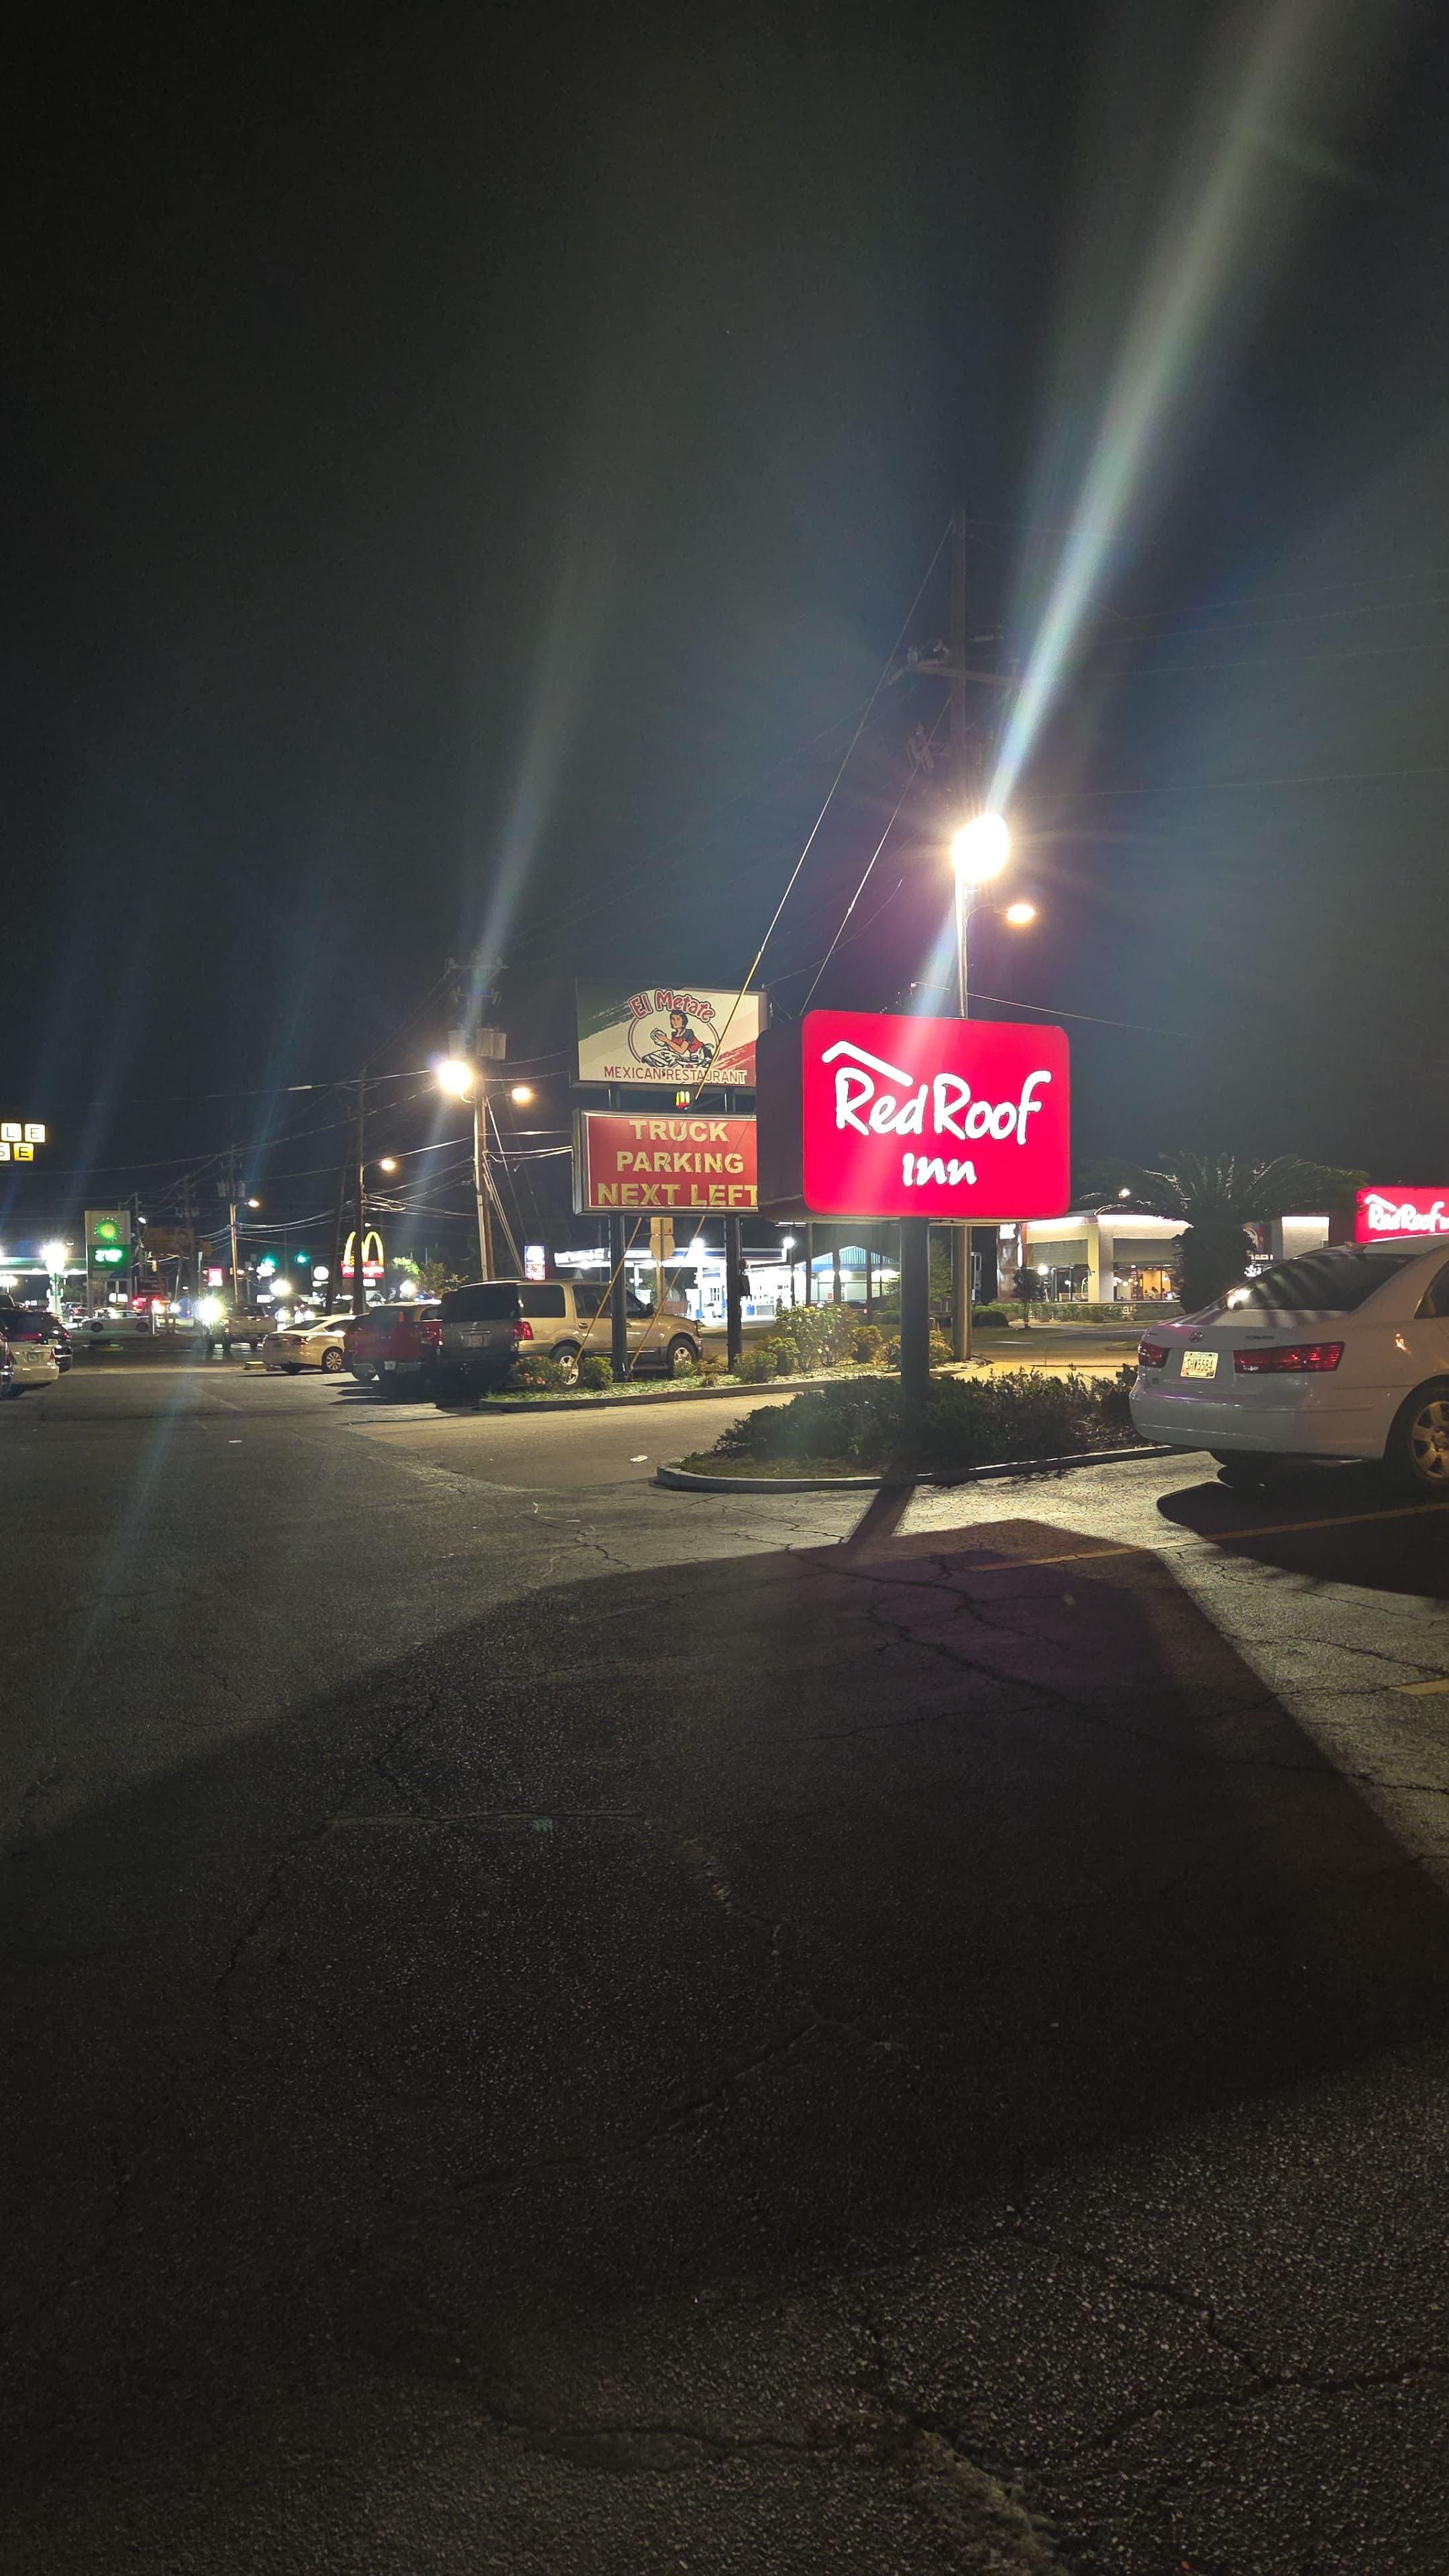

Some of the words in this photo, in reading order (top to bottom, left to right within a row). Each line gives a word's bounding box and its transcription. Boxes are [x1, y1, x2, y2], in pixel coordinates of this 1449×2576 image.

[629, 993, 653, 1020] El
[654, 989, 716, 1023] Metate
[604, 1066, 661, 1080] MEXICAN
[666, 1068, 747, 1085] RESTAURANT
[835, 1067, 928, 1136] Red
[933, 1070, 1052, 1145] Roof
[629, 1120, 730, 1142] TRUCK
[616, 1151, 744, 1174] PARKING
[902, 1152, 977, 1186] Inn
[597, 1183, 681, 1205] NEXT
[690, 1184, 758, 1207] LEFT
